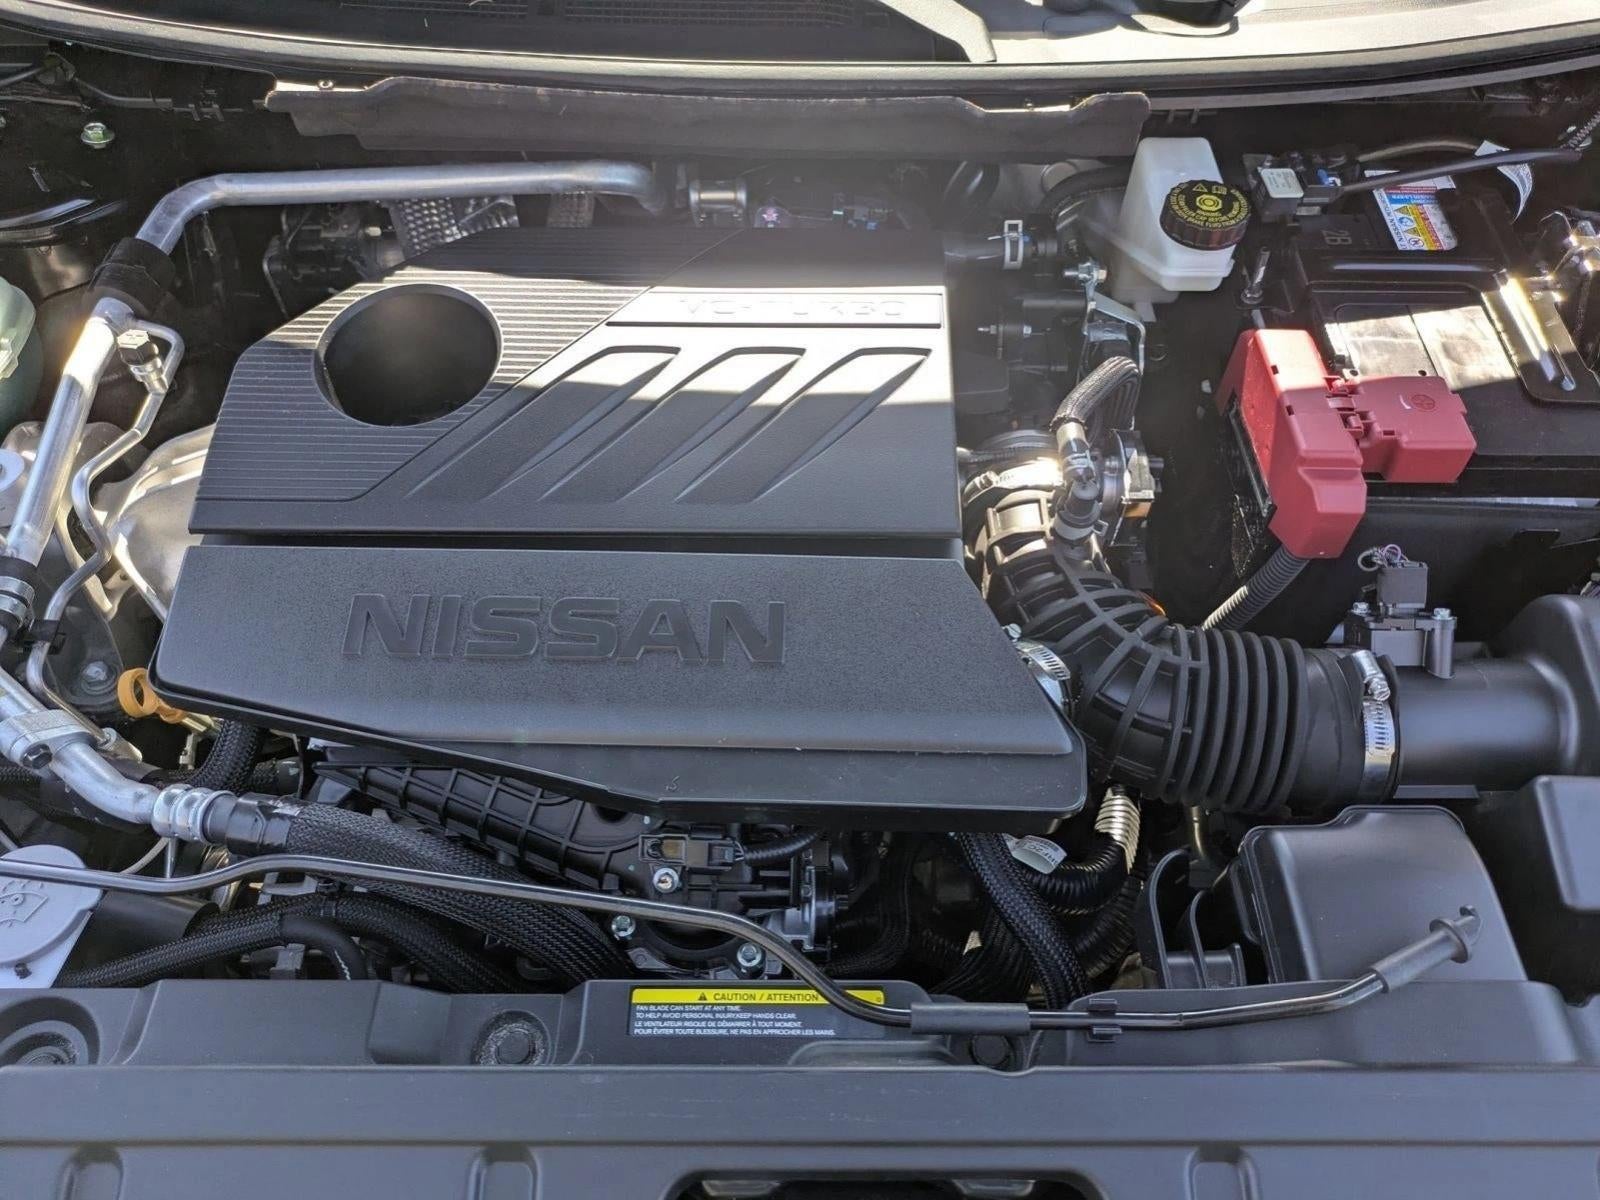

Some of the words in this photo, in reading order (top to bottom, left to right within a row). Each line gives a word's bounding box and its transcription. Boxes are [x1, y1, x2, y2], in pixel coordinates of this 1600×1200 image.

[342, 593, 786, 664] NISSAN
[713, 992, 757, 1001] CAUTION
[767, 993, 819, 1002] ATTENTION
[633, 1028, 653, 1036] POUR
[675, 1028, 695, 1036] TOUTE
[740, 1028, 753, 1036] PAS
[763, 1028, 801, 1036] APPROCHER
[802, 1028, 814, 1036] LES
